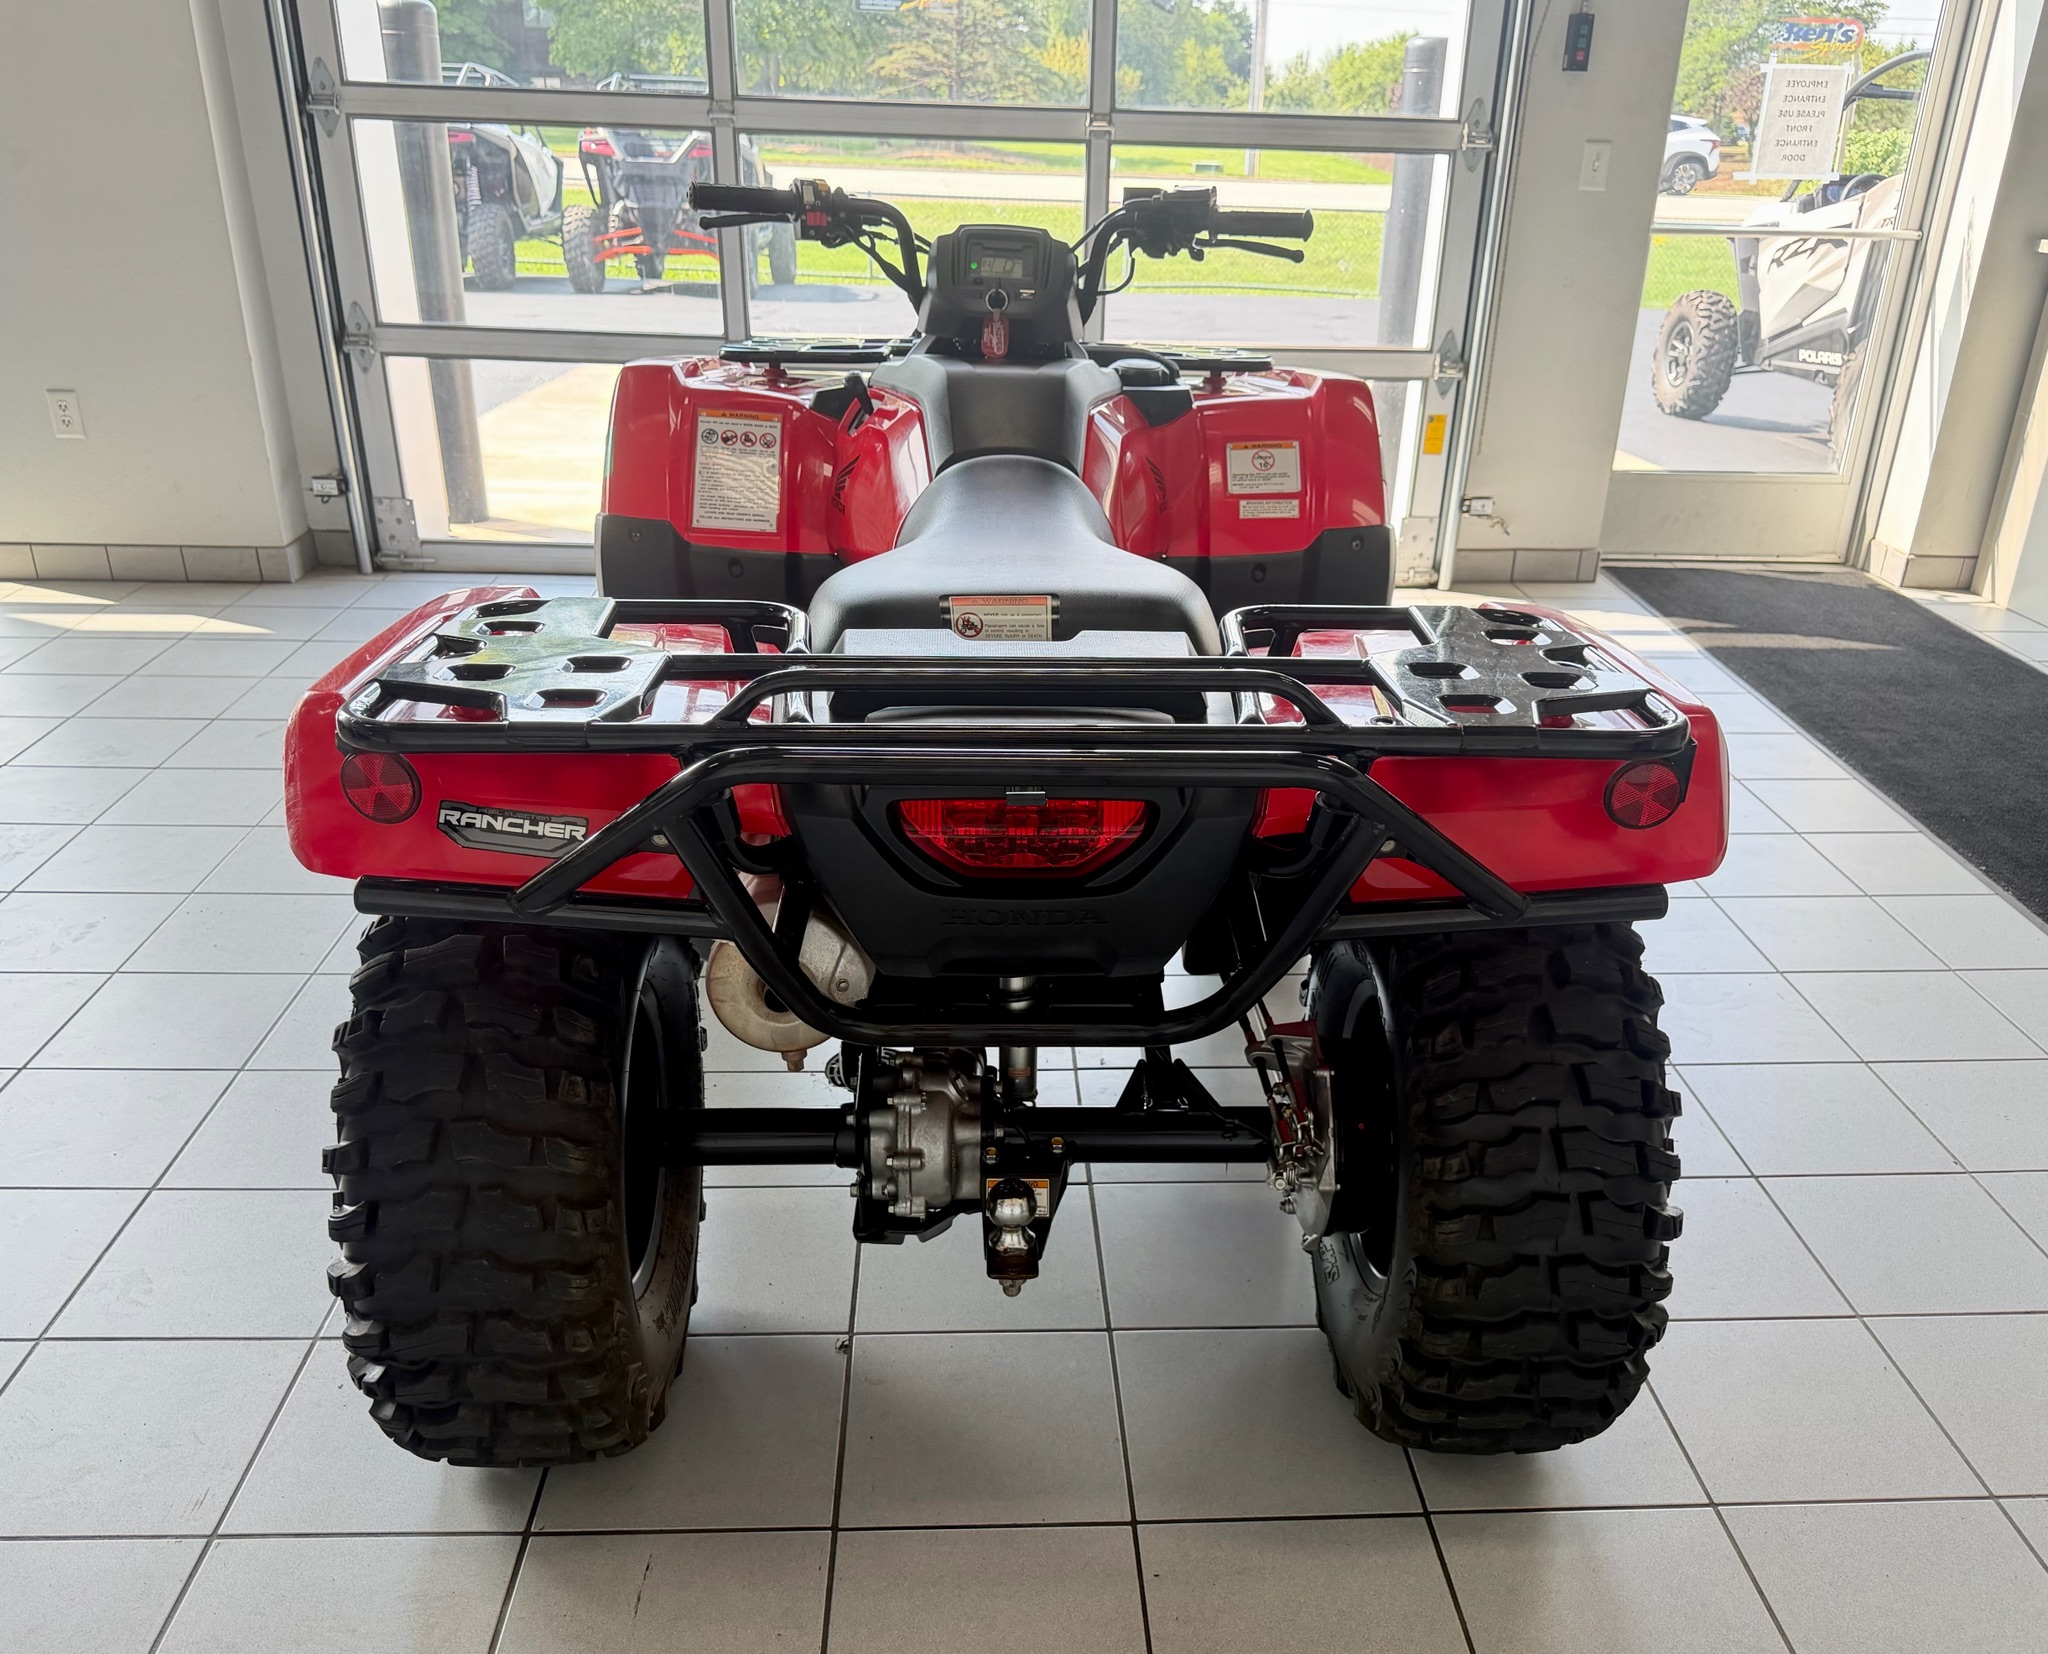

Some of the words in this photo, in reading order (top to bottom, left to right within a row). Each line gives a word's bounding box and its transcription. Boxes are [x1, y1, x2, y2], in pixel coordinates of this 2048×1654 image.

[1780, 22, 1856, 43] Ken's
[1803, 36, 1857, 59] Sports
[1798, 349, 1843, 366] POLARIS
[729, 412, 760, 420] WARNING
[478, 808, 503, 816] FUEL
[504, 811, 550, 821] INJECTION
[438, 808, 587, 842] RANCHER
[941, 908, 1110, 926] HONDA
